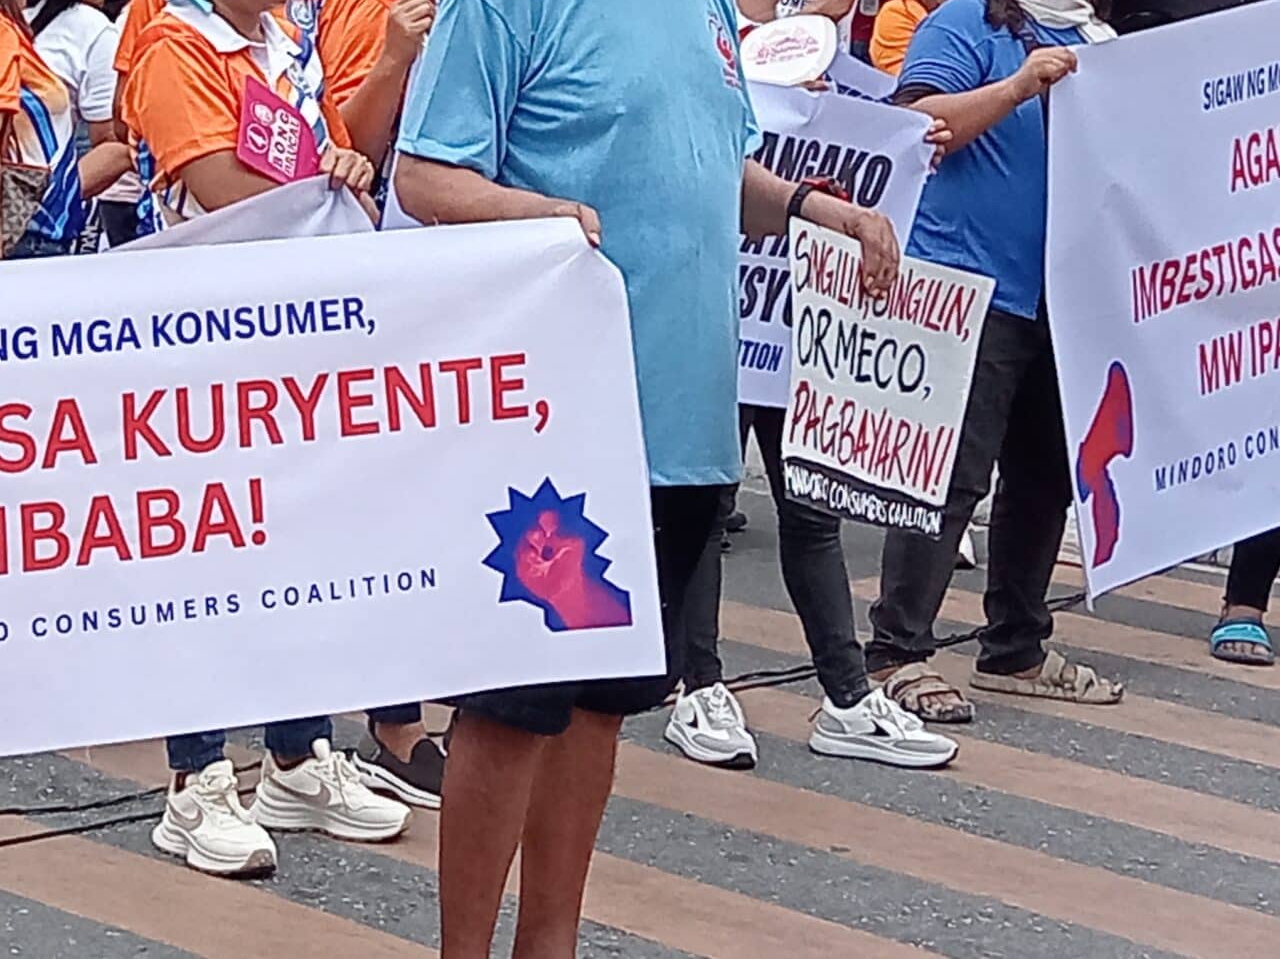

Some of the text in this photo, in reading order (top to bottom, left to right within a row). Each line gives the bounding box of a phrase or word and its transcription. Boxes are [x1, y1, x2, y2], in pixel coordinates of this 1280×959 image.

[1204, 63, 1280, 110] SIGAW NG M
[51, 317, 142, 357] MGA
[151, 297, 376, 348] KONSUMER,
[740, 339, 784, 373] TION
[797, 305, 932, 399] ORMECO,
[1199, 331, 1243, 395] MW
[121, 352, 550, 461] KURYENTE,
[788, 380, 955, 496] PAGBAYARIN!
[1155, 442, 1236, 492] MINDORO
[783, 461, 829, 502] MINDORO
[31, 593, 241, 638] CONSUMERS
[261, 567, 438, 610] COALITION
